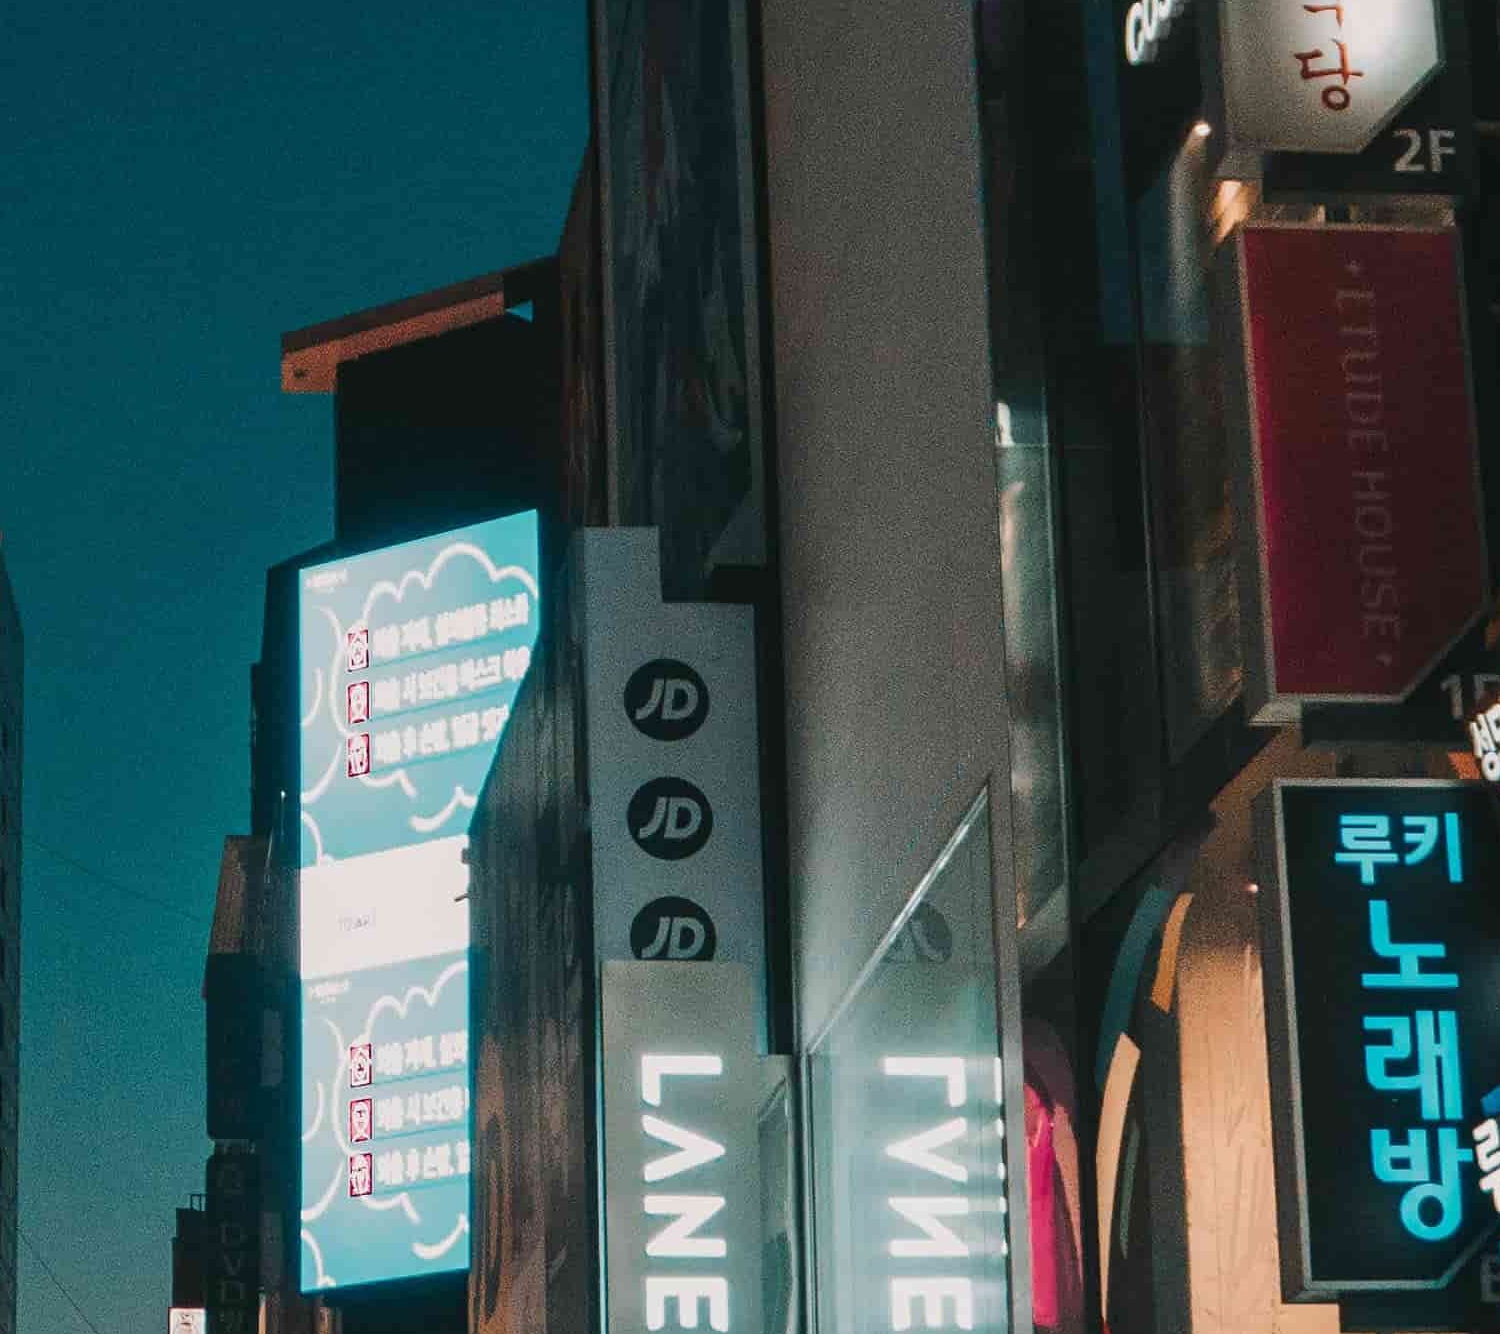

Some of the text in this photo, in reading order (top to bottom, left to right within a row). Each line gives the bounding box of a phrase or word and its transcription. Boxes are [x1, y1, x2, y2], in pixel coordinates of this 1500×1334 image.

[1393, 128, 1458, 173] 2F
[1350, 462, 1402, 645] HOUSE
[634, 677, 699, 722] JD
[638, 795, 703, 841] JD
[1334, 812, 1463, 885] 루키
[642, 914, 706, 960] JD
[1360, 899, 1473, 1241] 노래방
